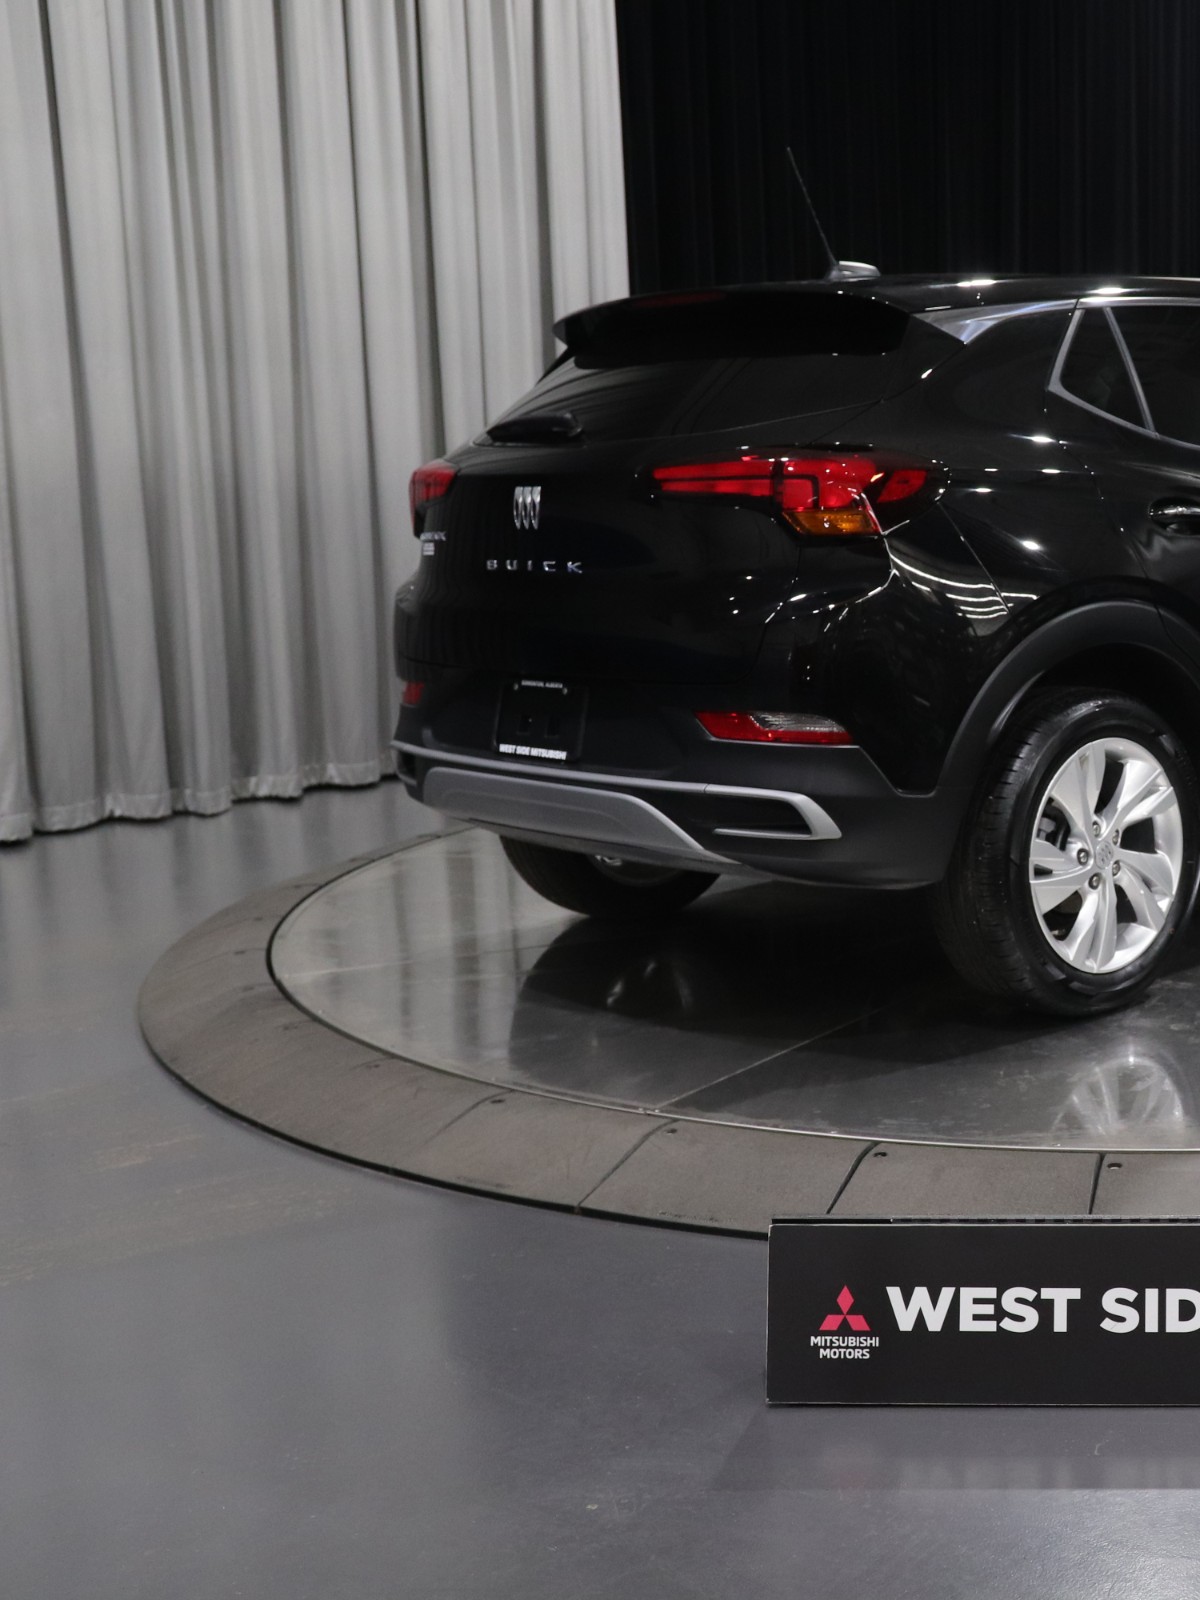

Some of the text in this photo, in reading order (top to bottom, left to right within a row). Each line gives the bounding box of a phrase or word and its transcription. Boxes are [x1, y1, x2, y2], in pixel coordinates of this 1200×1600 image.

[486, 559, 583, 573] BUICK
[885, 1286, 1081, 1332] WEST
[810, 1335, 880, 1347] MITSUBISHI
[819, 1348, 870, 1359] MOTORS
